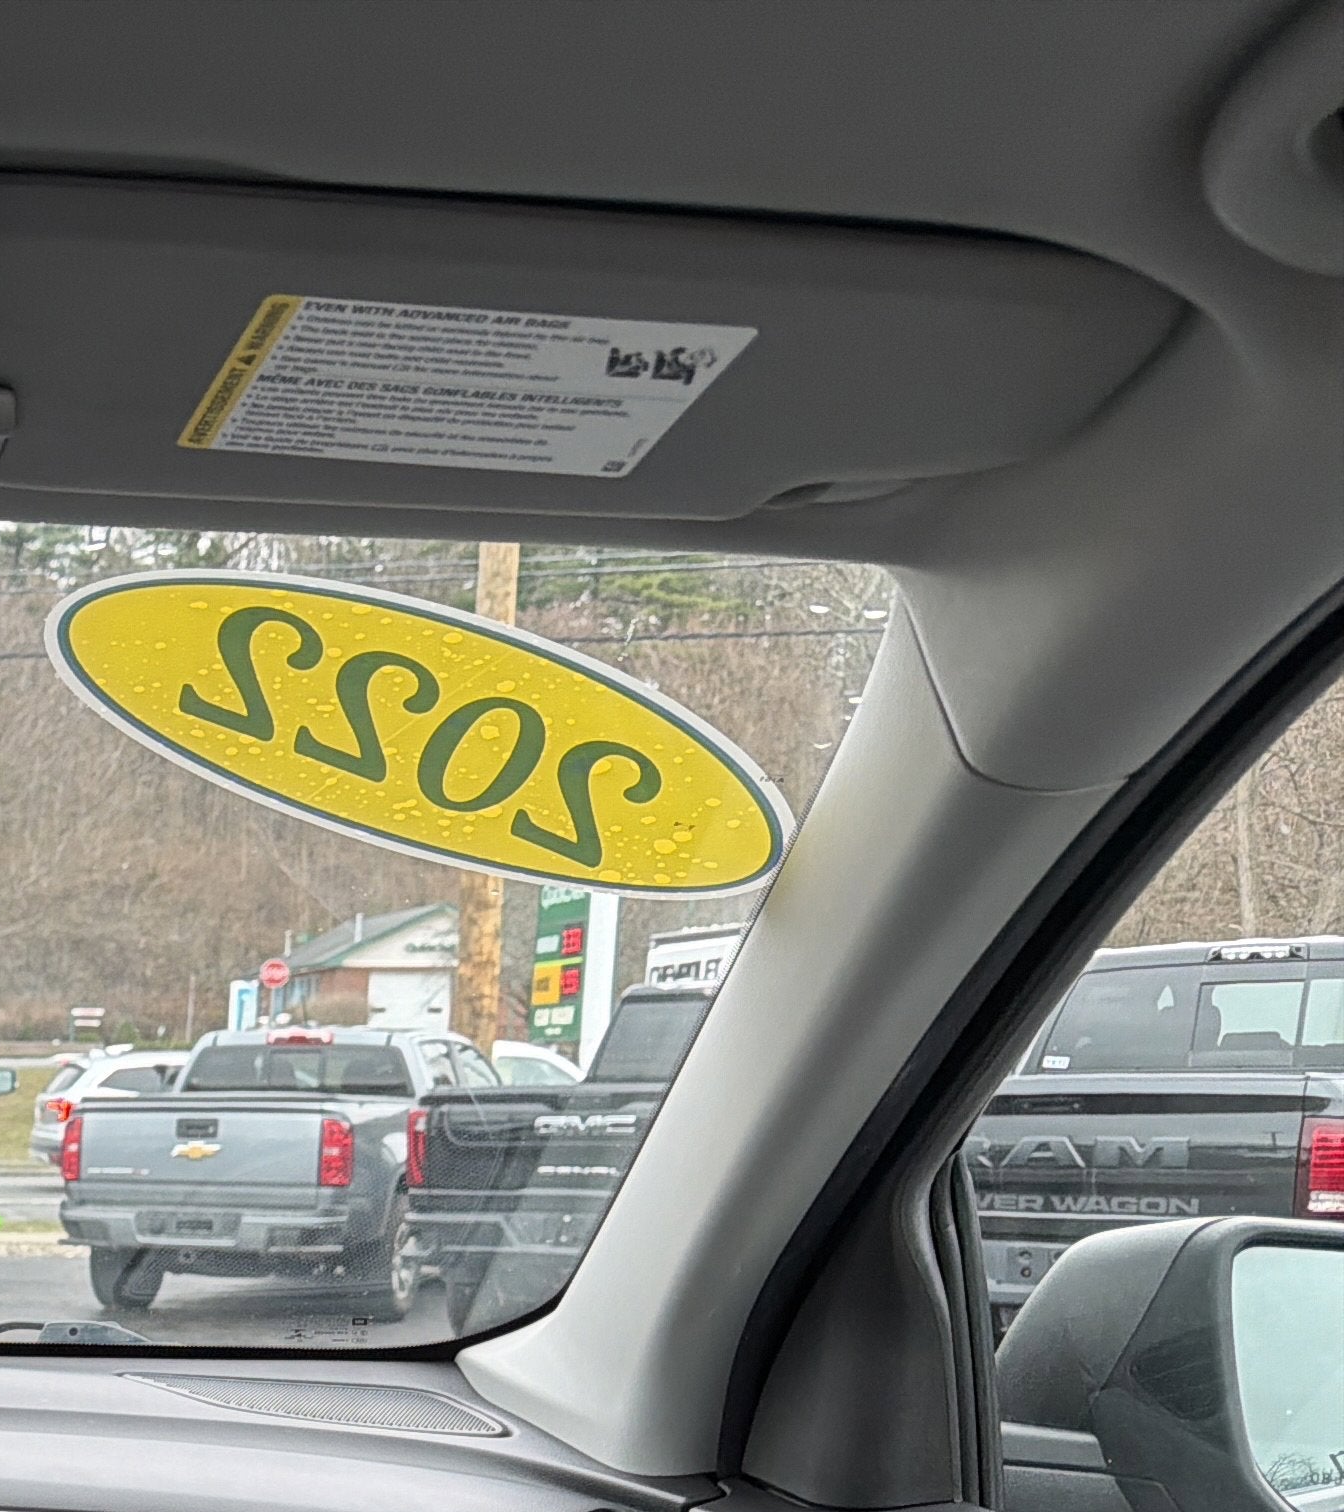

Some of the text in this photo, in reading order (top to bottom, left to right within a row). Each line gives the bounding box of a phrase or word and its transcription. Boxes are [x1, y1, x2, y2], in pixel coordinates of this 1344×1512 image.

[348, 305, 396, 316] WITH
[534, 1114, 637, 1135] GMC
[1050, 1195, 1200, 1215] WAGON
